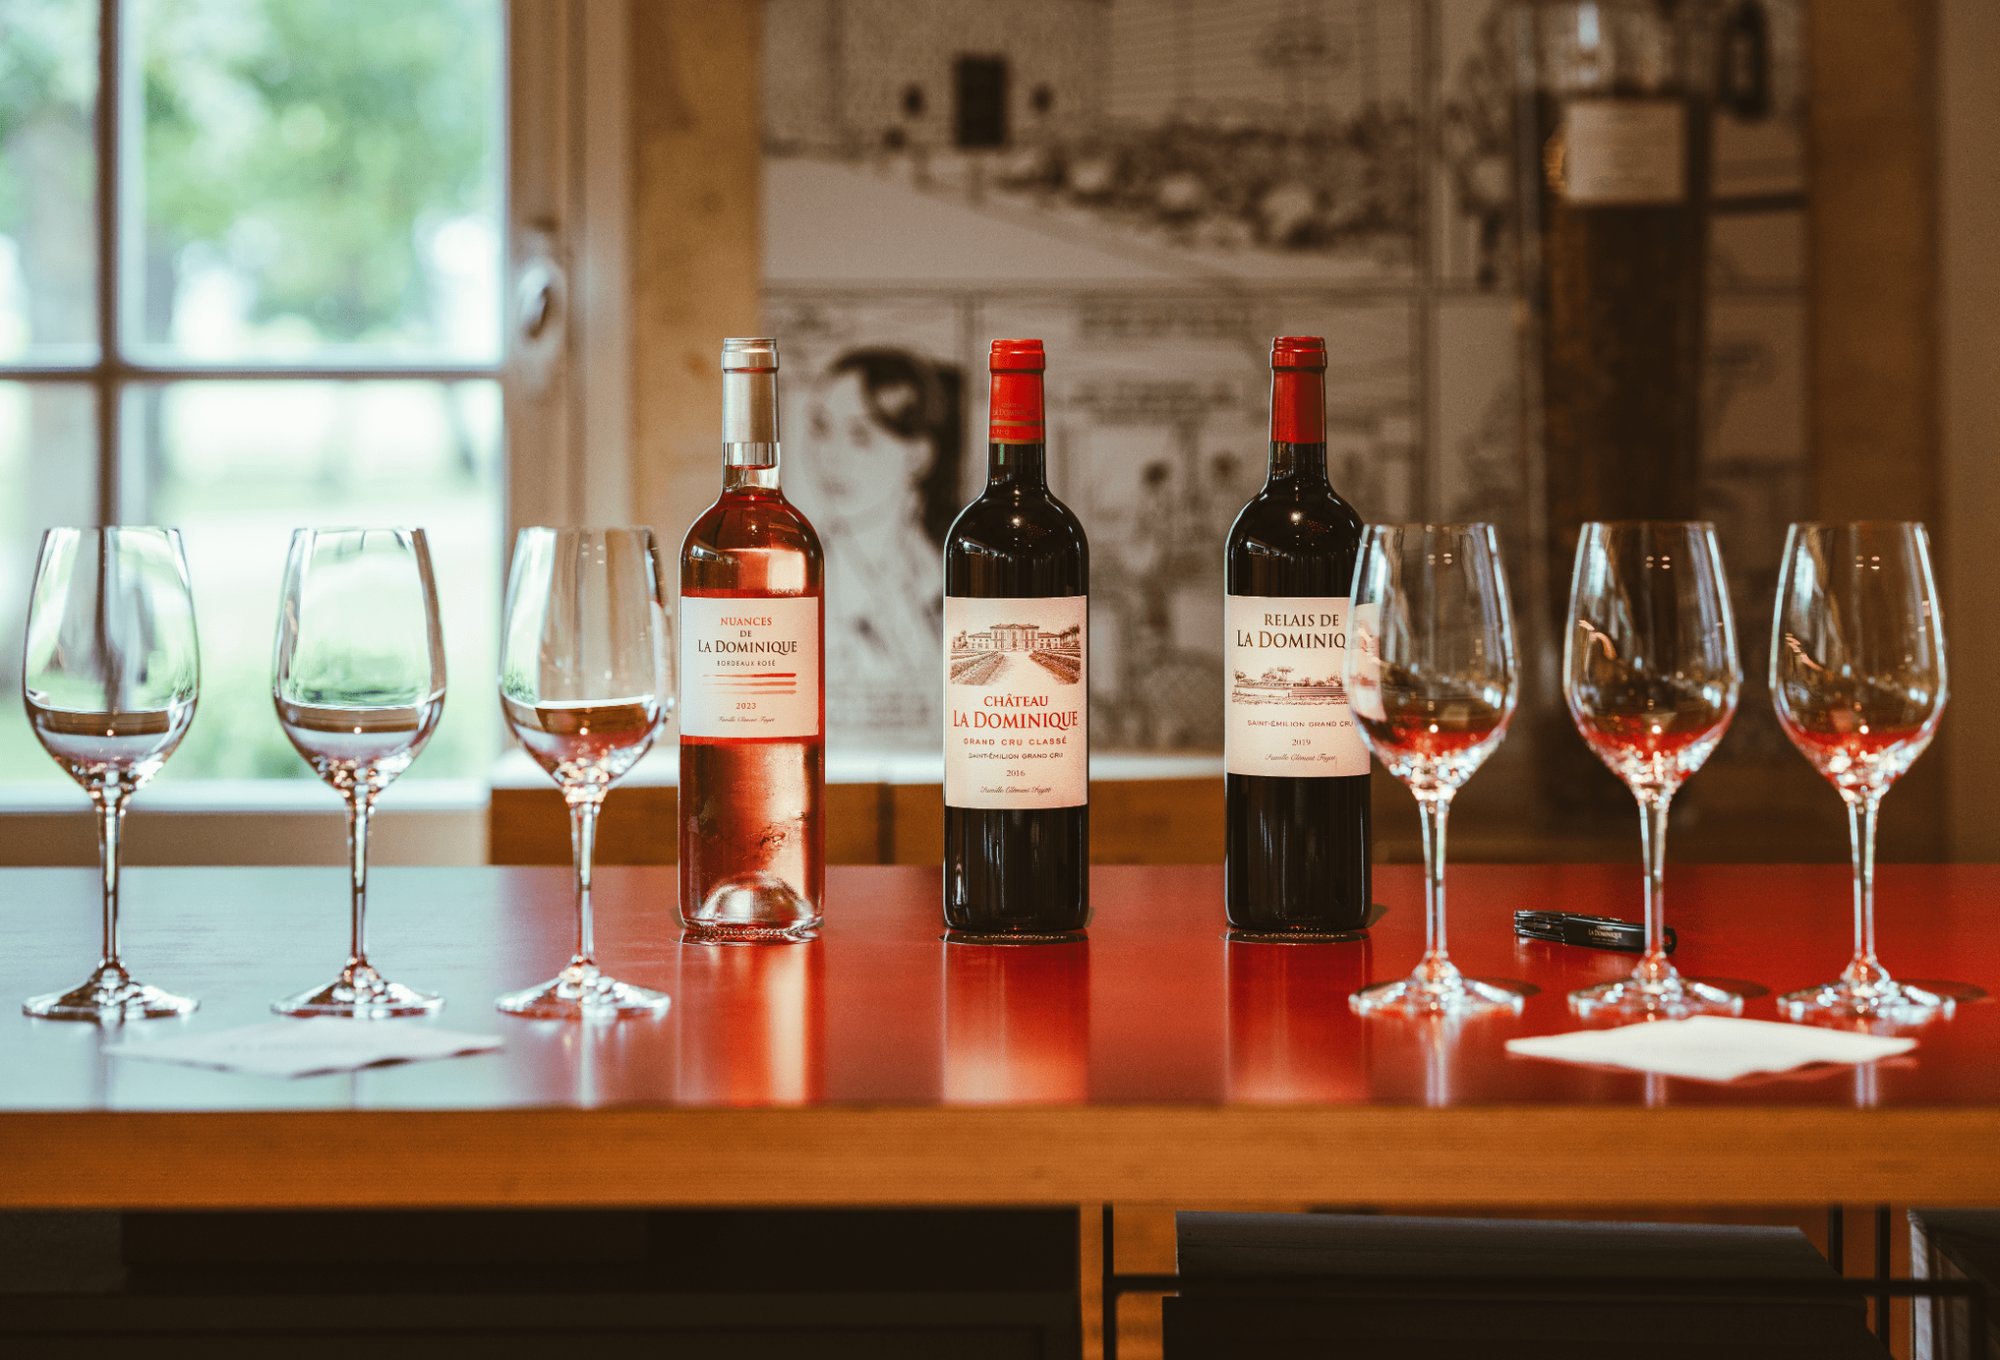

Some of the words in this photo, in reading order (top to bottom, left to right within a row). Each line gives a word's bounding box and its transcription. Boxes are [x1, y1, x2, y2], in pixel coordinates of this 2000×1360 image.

[720, 617, 772, 626] NUANCES
[1264, 613, 1315, 627] RELAIS
[1320, 614, 1339, 626] DE
[740, 630, 752, 638] DE
[1237, 629, 1253, 647] LA
[1259, 631, 1347, 649] DOMINIQ
[698, 639, 712, 653] LA
[715, 640, 798, 655] DOMINIQUE
[757, 659, 776, 667] ROSÉ
[983, 693, 1049, 707] CHÂTEAU
[736, 702, 757, 710] 2023
[953, 710, 969, 728] LA
[974, 711, 1078, 731] DOMINIQUE
[1309, 719, 1337, 728] GRAND
[1339, 720, 1354, 728] CRU
[963, 737, 995, 746] GRAND
[1001, 738, 1023, 746] CRU
[1029, 735, 1067, 745] CLASSÉ
[1021, 752, 1048, 760] GRAND
[1006, 769, 1026, 777] 2016
